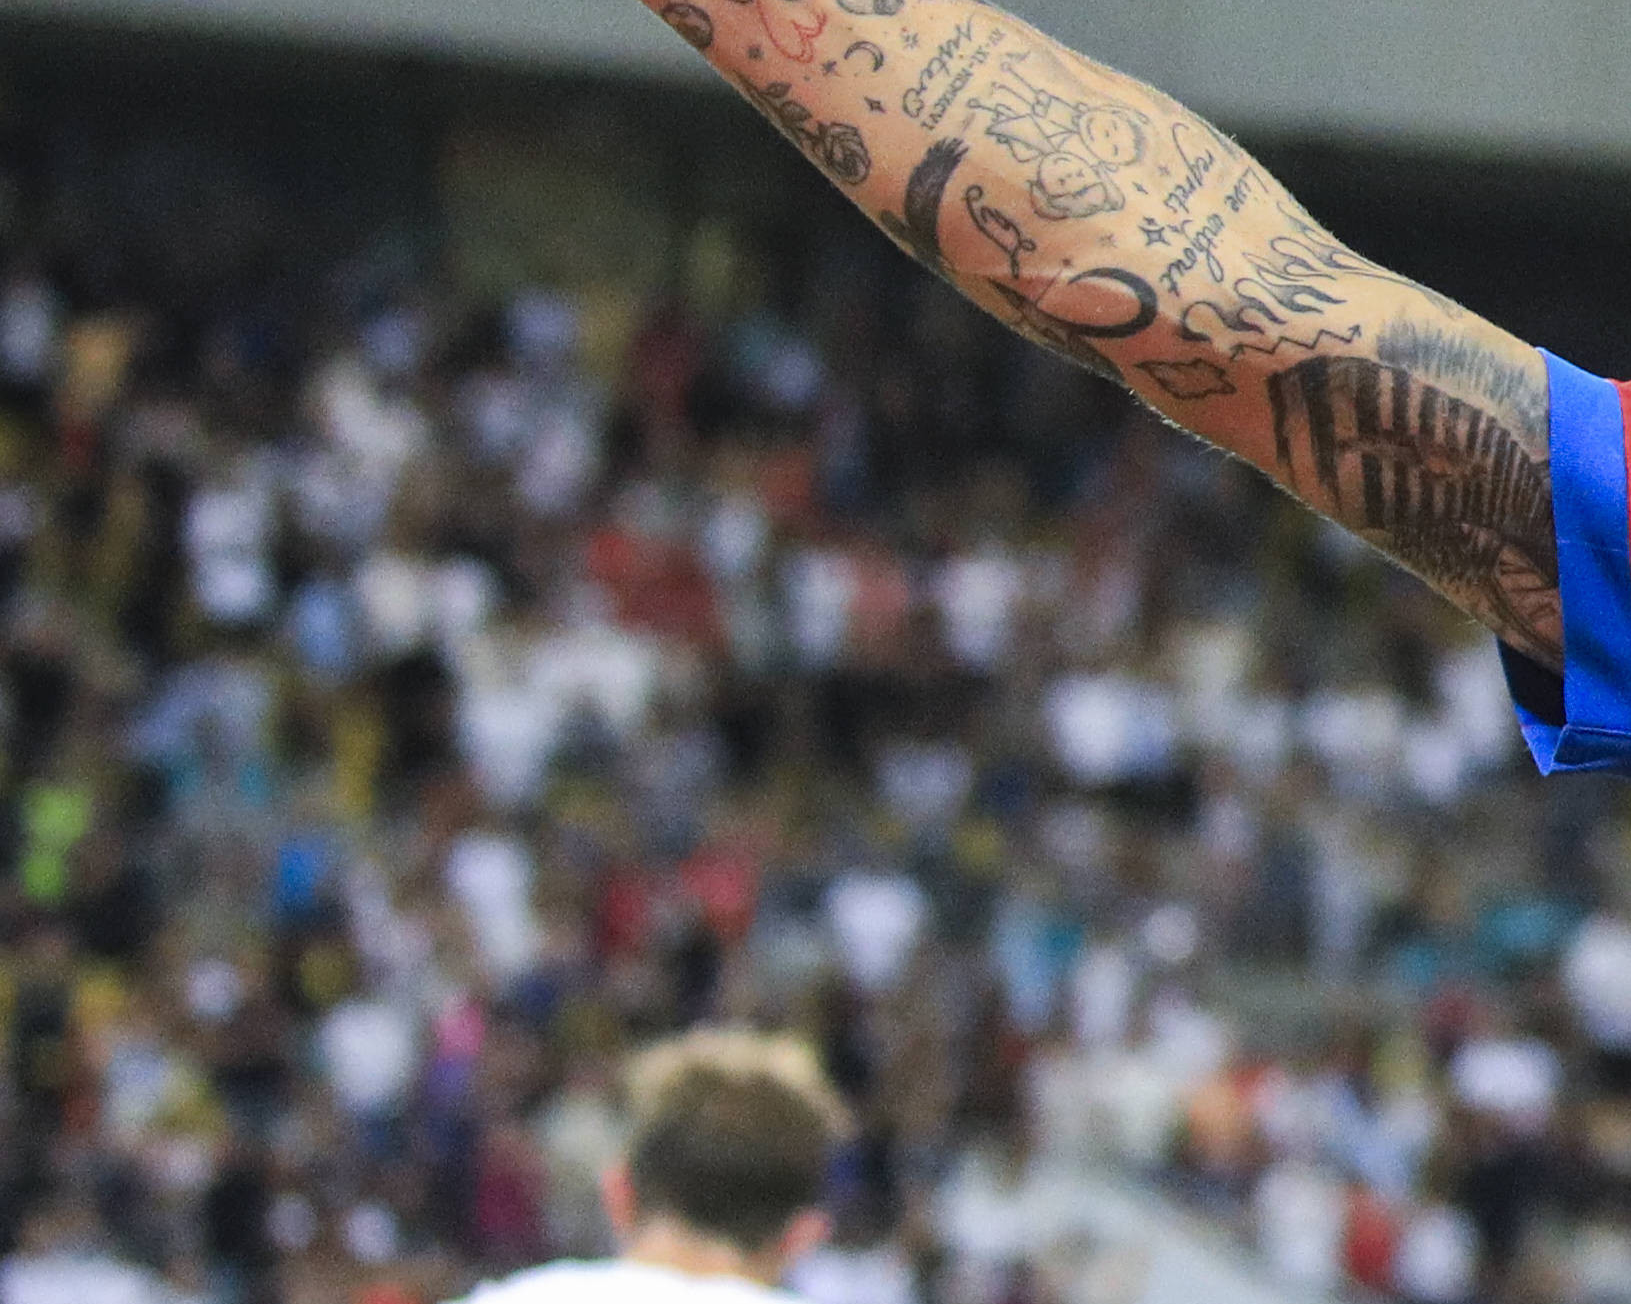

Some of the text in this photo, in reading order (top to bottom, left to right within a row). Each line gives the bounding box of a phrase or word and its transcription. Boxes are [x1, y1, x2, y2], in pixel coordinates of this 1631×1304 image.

[1164, 123, 1214, 214] regrets
[1160, 166, 1269, 296] Live without
